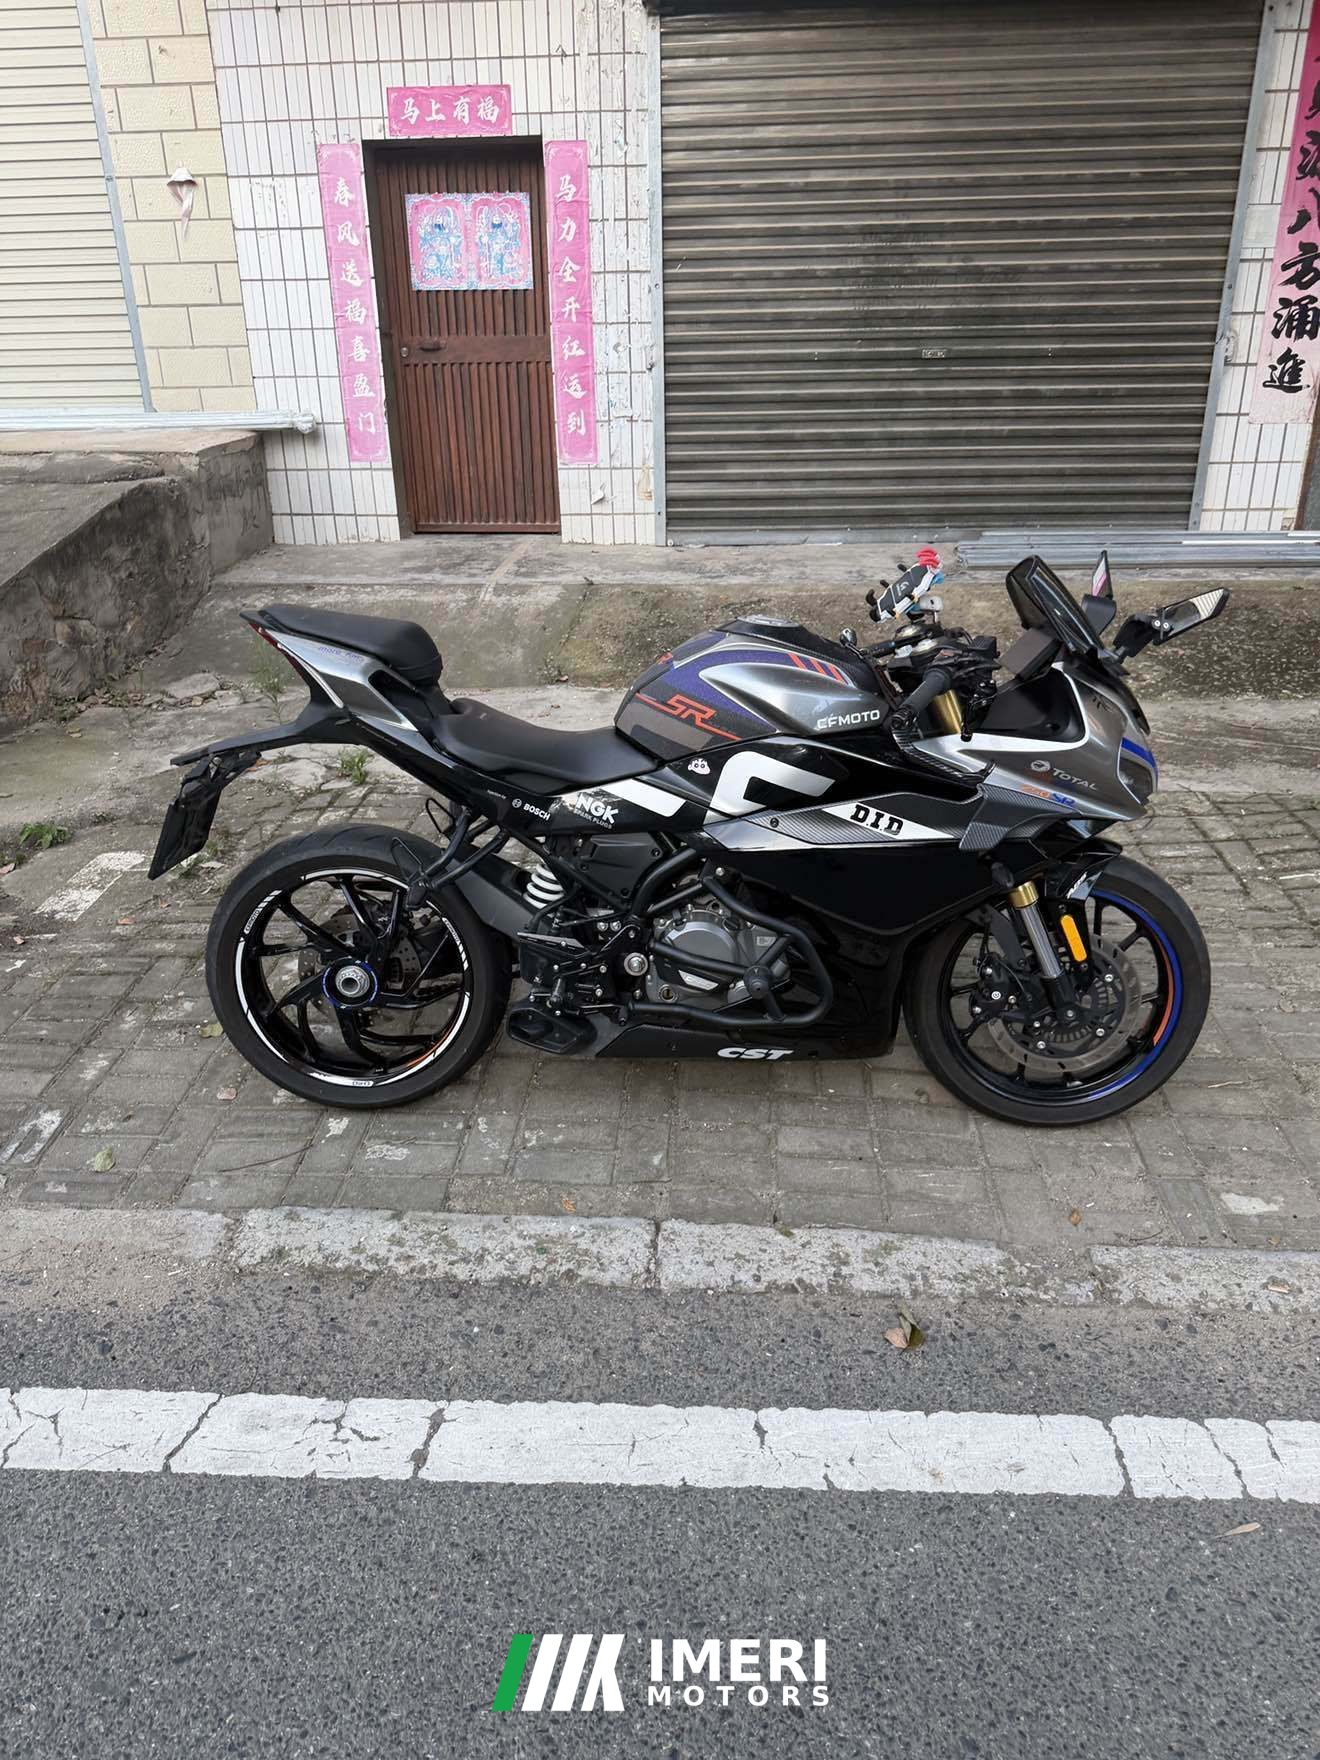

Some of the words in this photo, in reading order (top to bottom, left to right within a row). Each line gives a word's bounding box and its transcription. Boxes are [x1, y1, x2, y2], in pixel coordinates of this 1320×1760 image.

[400, 96, 500, 125] 马上有福
[334, 176, 376, 434] 春风送福喜盈门
[556, 174, 587, 436] 马力全开红运到
[816, 709, 880, 729] CFMOTO
[1053, 768, 1097, 791] TOTAL
[523, 803, 551, 821] BOSCH
[575, 792, 619, 824] NGK
[717, 1047, 794, 1060] CST
